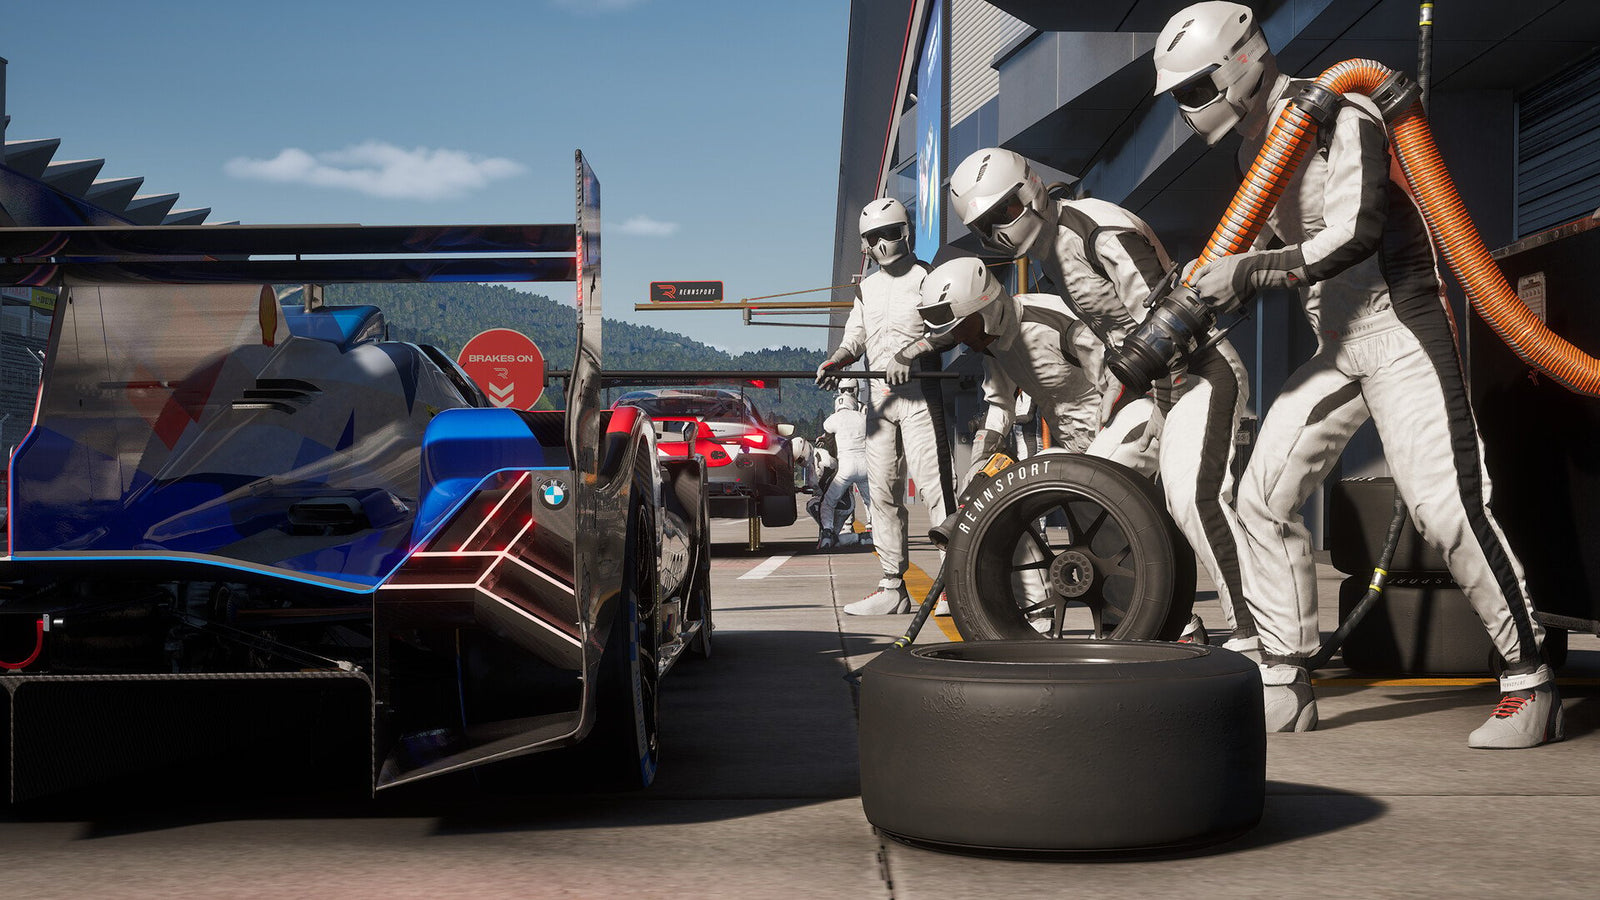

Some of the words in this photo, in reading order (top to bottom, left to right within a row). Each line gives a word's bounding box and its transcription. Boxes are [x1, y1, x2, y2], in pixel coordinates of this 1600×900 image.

[679, 288, 716, 296] RENNSPORT
[468, 354, 516, 363] BRAKES
[516, 354, 533, 363] ON
[540, 479, 568, 491] BMW
[958, 460, 1051, 534] RENNSPORT
